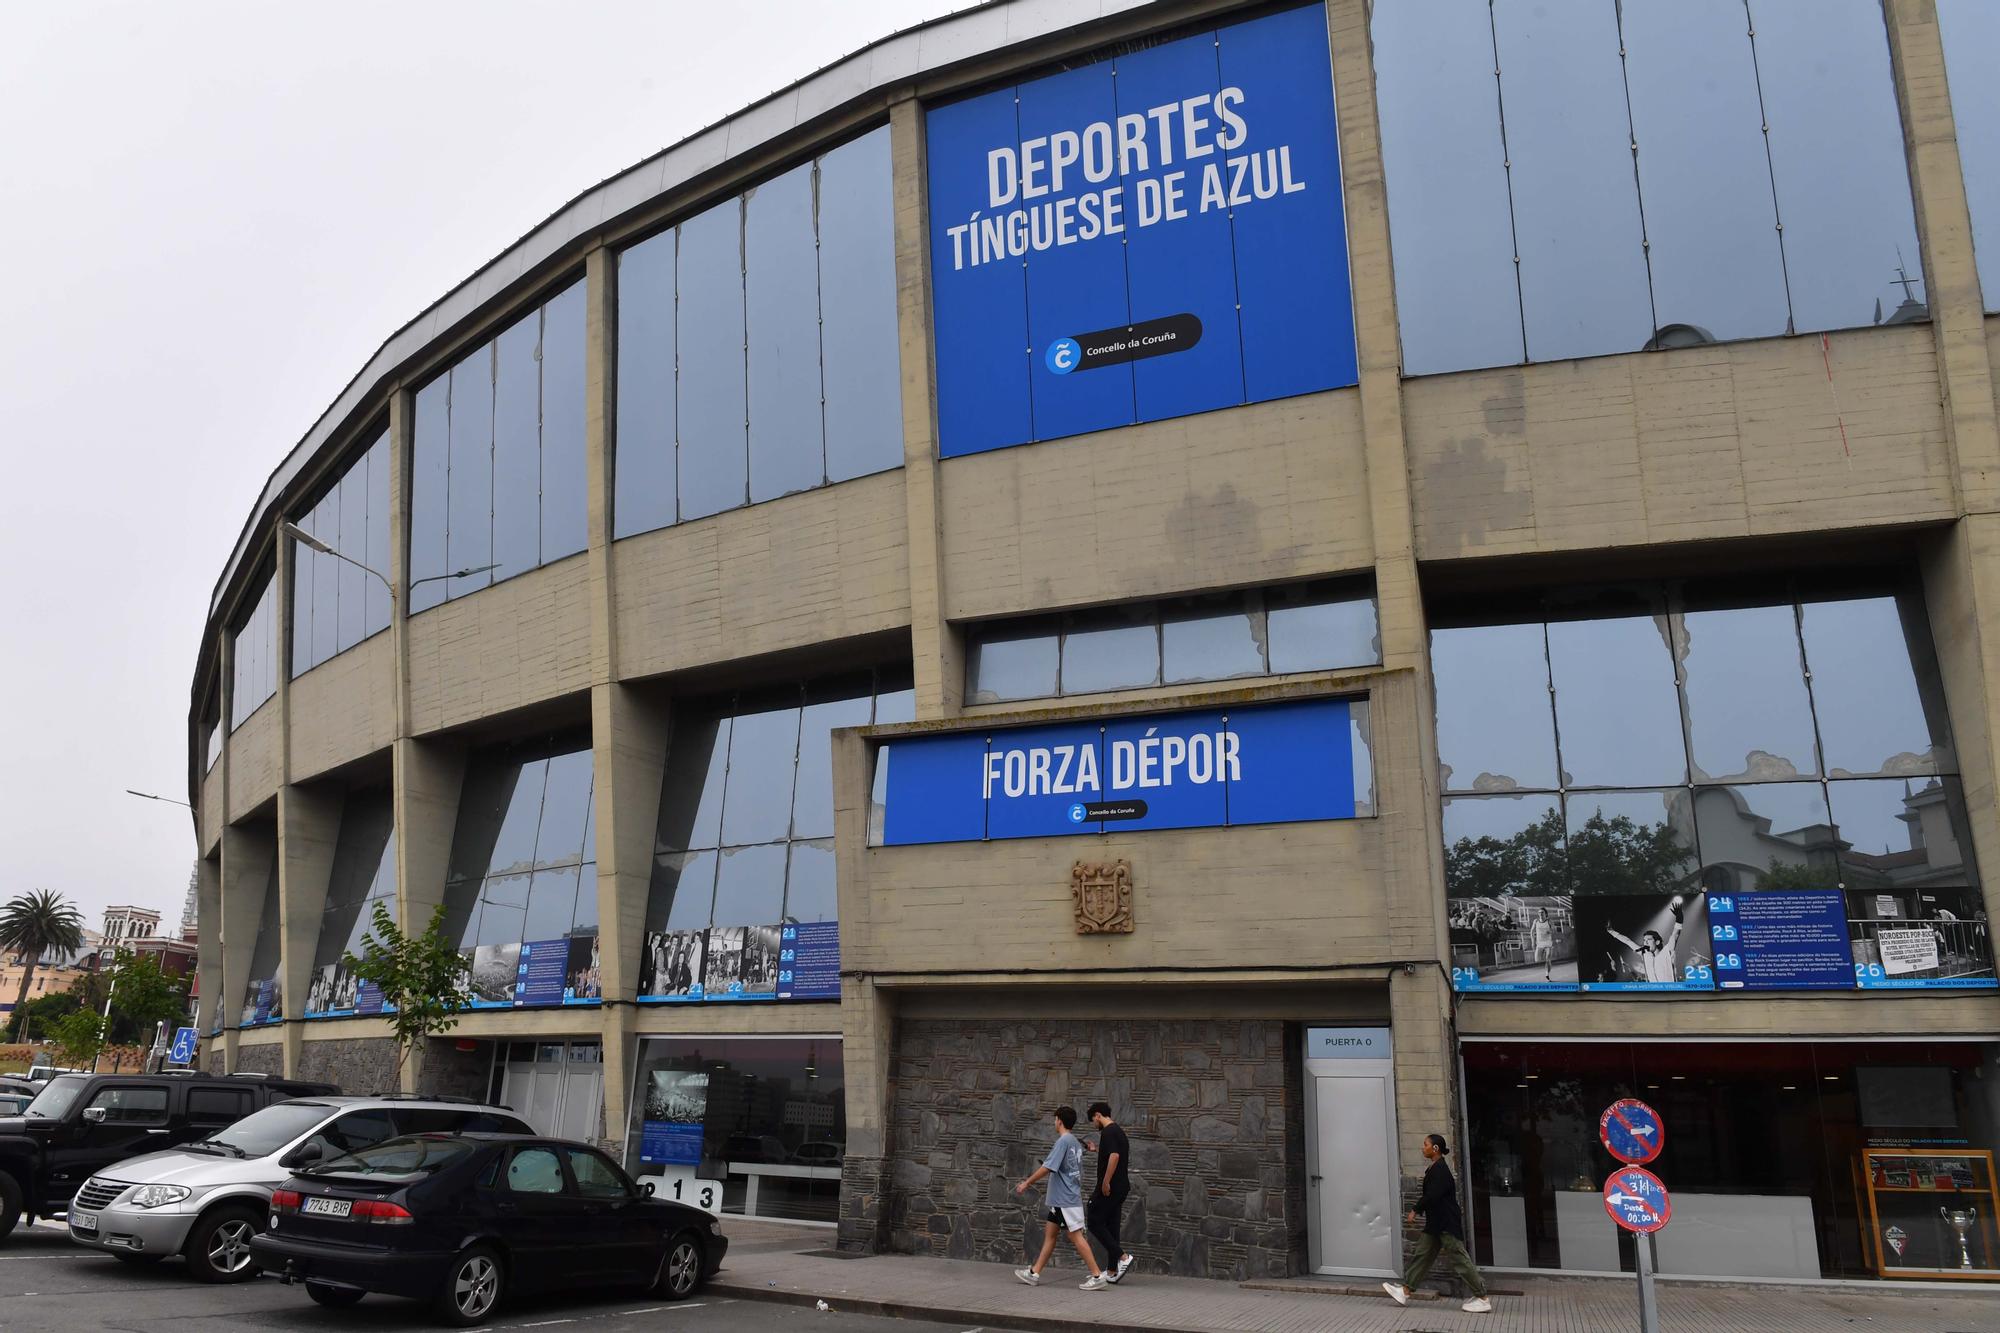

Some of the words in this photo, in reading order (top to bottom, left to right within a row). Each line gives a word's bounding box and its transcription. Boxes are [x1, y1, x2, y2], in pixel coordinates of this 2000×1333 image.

[988, 87, 1247, 208] DEPORTES
[947, 187, 1126, 270] TÍNGUESE
[1136, 171, 1188, 227] DE
[1199, 145, 1305, 213] AZUL
[1086, 342, 1125, 356] Concello
[1128, 340, 1140, 348] da
[1142, 331, 1176, 346] Coruña
[983, 743, 1101, 798] FORZA
[1112, 727, 1241, 790] DÉPOR
[1709, 897, 1731, 910] 24
[783, 927, 795, 938] 21
[1713, 925, 1734, 938] 25
[781, 949, 793, 960] 22
[1716, 953, 1740, 967] 26
[779, 970, 792, 981] 23
[1453, 967, 1475, 981] 24
[1685, 965, 1709, 979] 25
[1855, 963, 1880, 977] 26
[690, 982, 702, 993] 21
[728, 981, 741, 992] 22
[1325, 1038, 1362, 1046] PUERTA
[1601, 1102, 1624, 1127] EXCEPTO
[673, 1179, 682, 1199] 1
[700, 1187, 714, 1208] 3
[308, 1199, 330, 1212] 7743
[332, 1201, 350, 1214] BXR
